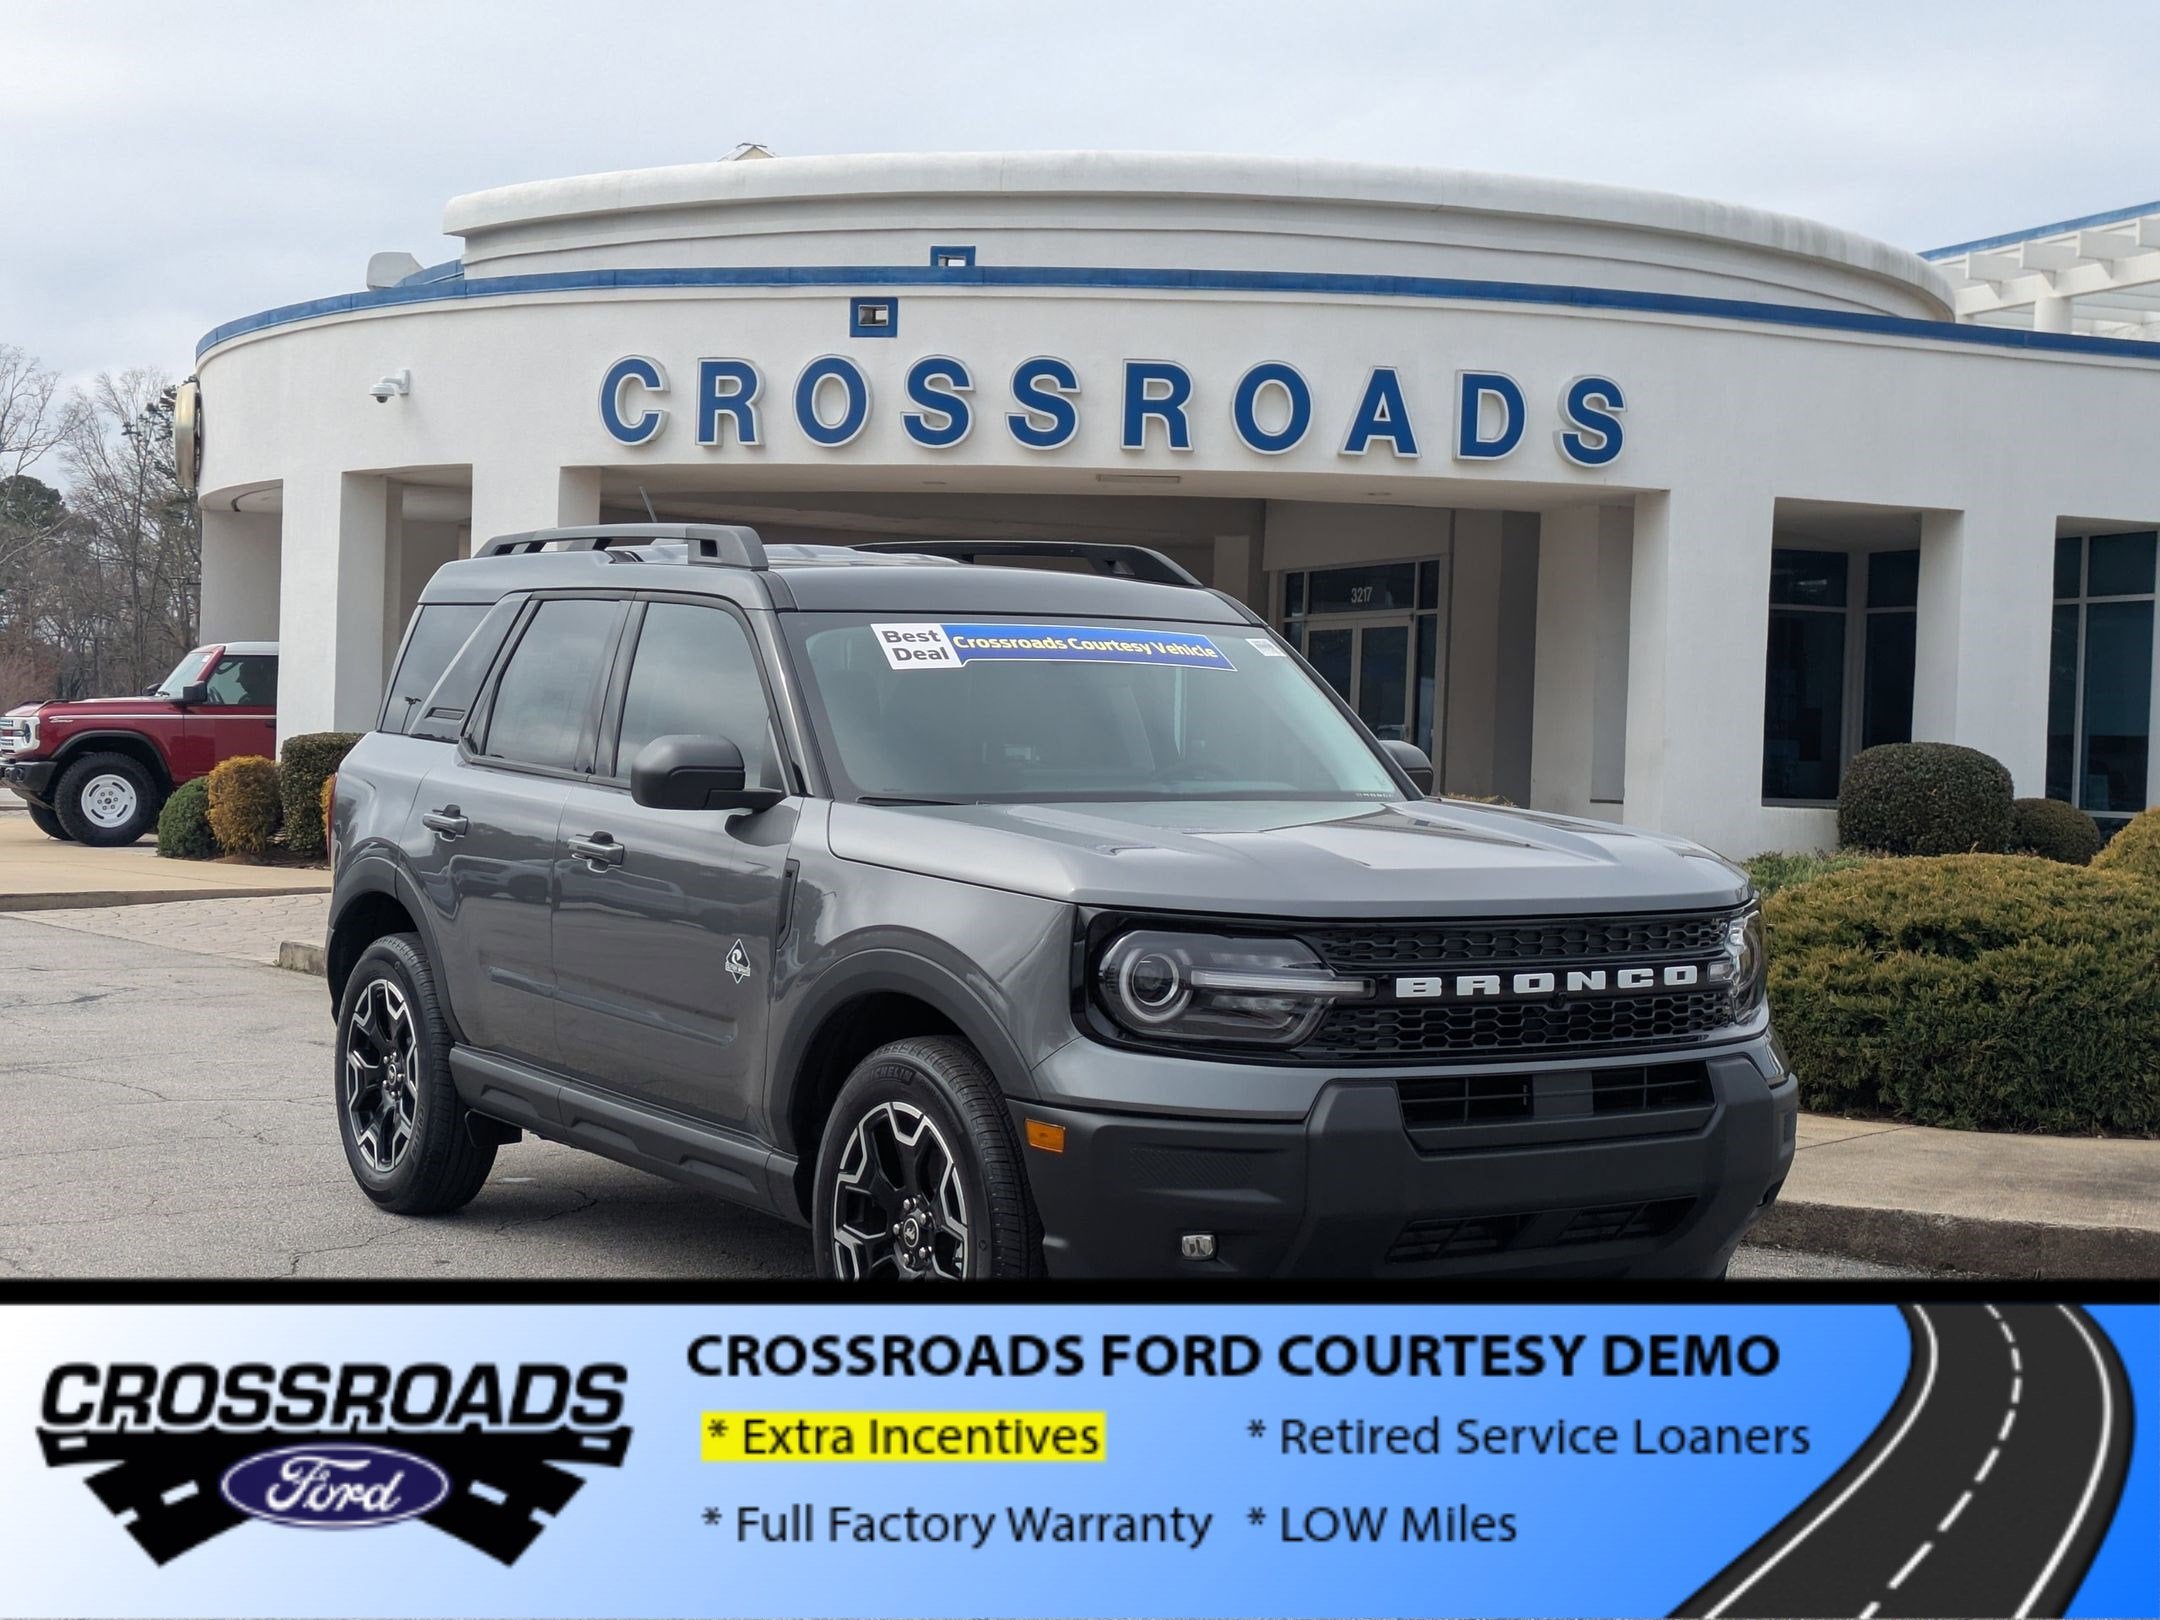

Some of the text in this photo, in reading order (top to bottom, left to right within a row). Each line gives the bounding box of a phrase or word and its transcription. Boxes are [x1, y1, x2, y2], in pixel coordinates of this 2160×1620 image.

[601, 355, 1626, 467] CROSSROADS
[1351, 586, 1373, 603] 3217
[881, 630, 941, 643] Best
[892, 647, 949, 661] Deal
[952, 636, 1218, 658] Crossroads Courtesy Vehicle
[1396, 965, 1698, 998] BRONCO
[862, 1066, 913, 1081] ICHELIN
